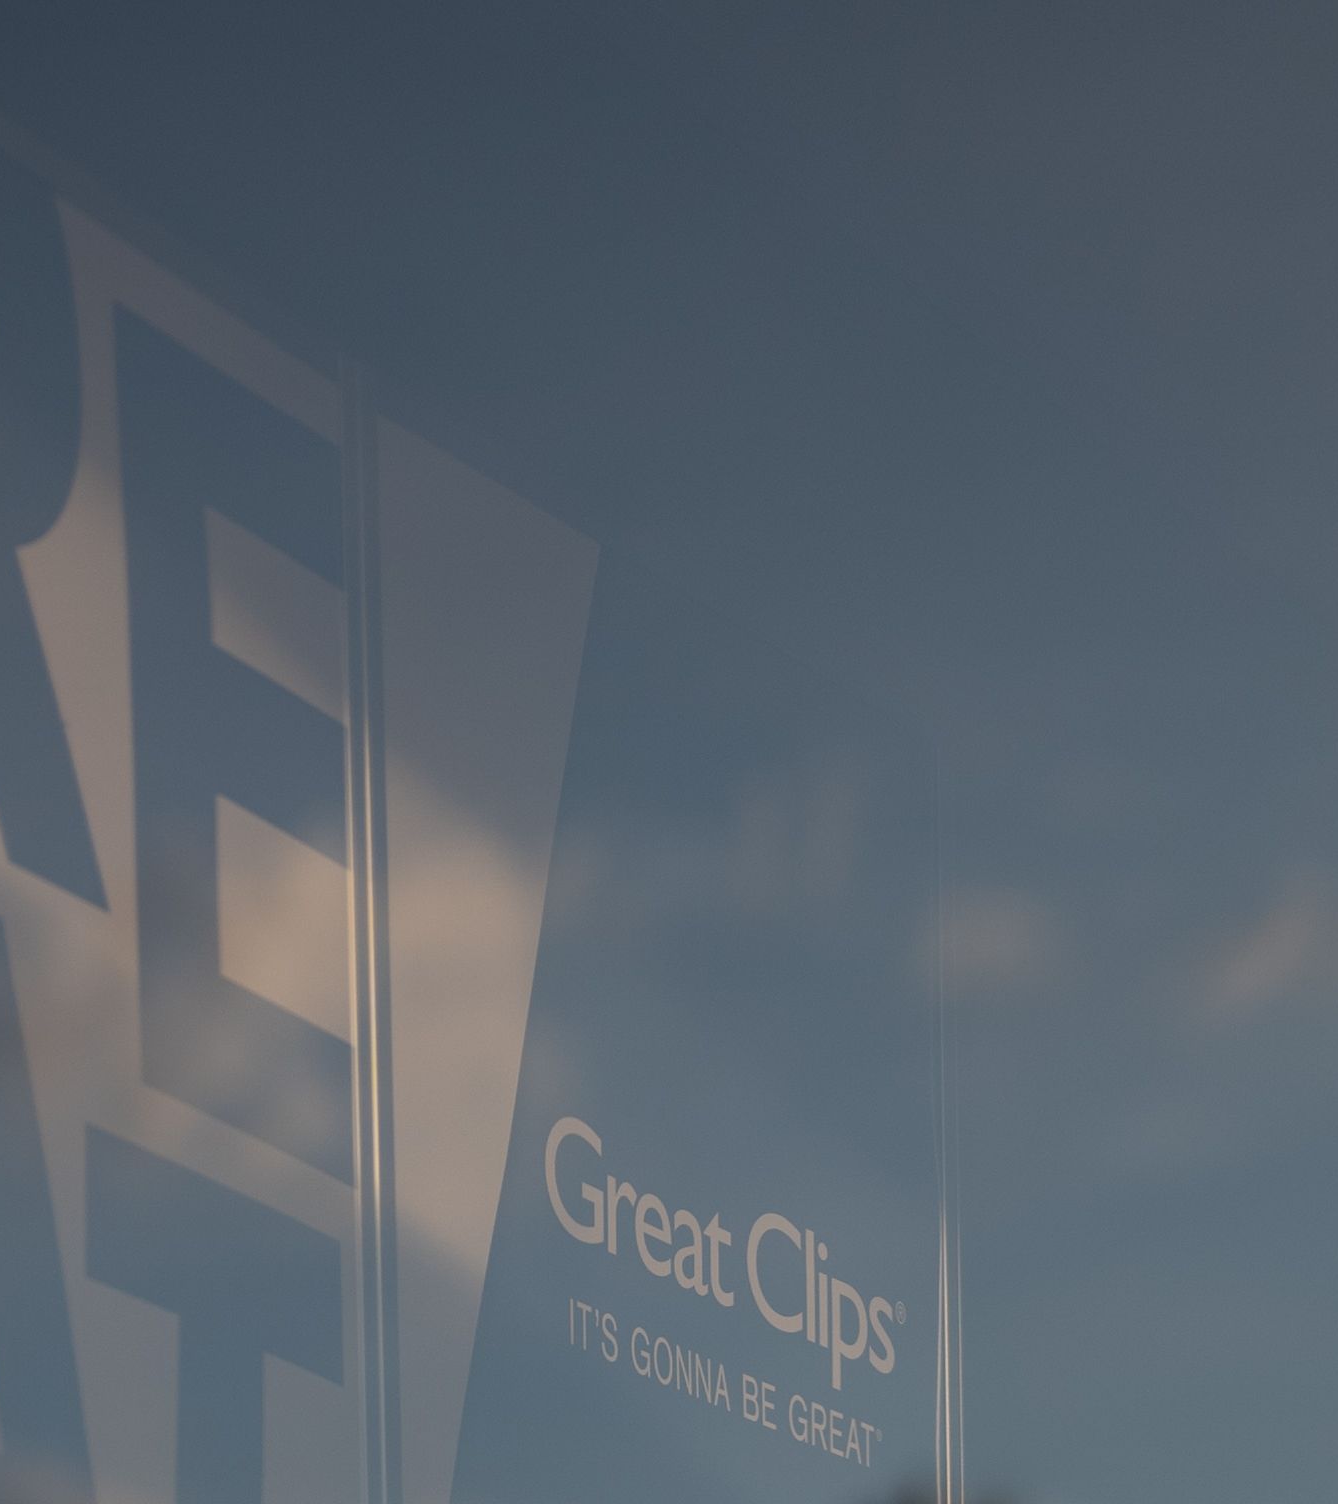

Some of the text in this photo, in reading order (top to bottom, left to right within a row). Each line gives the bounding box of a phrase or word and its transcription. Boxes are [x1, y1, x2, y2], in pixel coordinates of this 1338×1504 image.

[545, 1116, 897, 1391] Great Clips
[569, 1299, 875, 1468] IT'S GONNA BE GREAT
